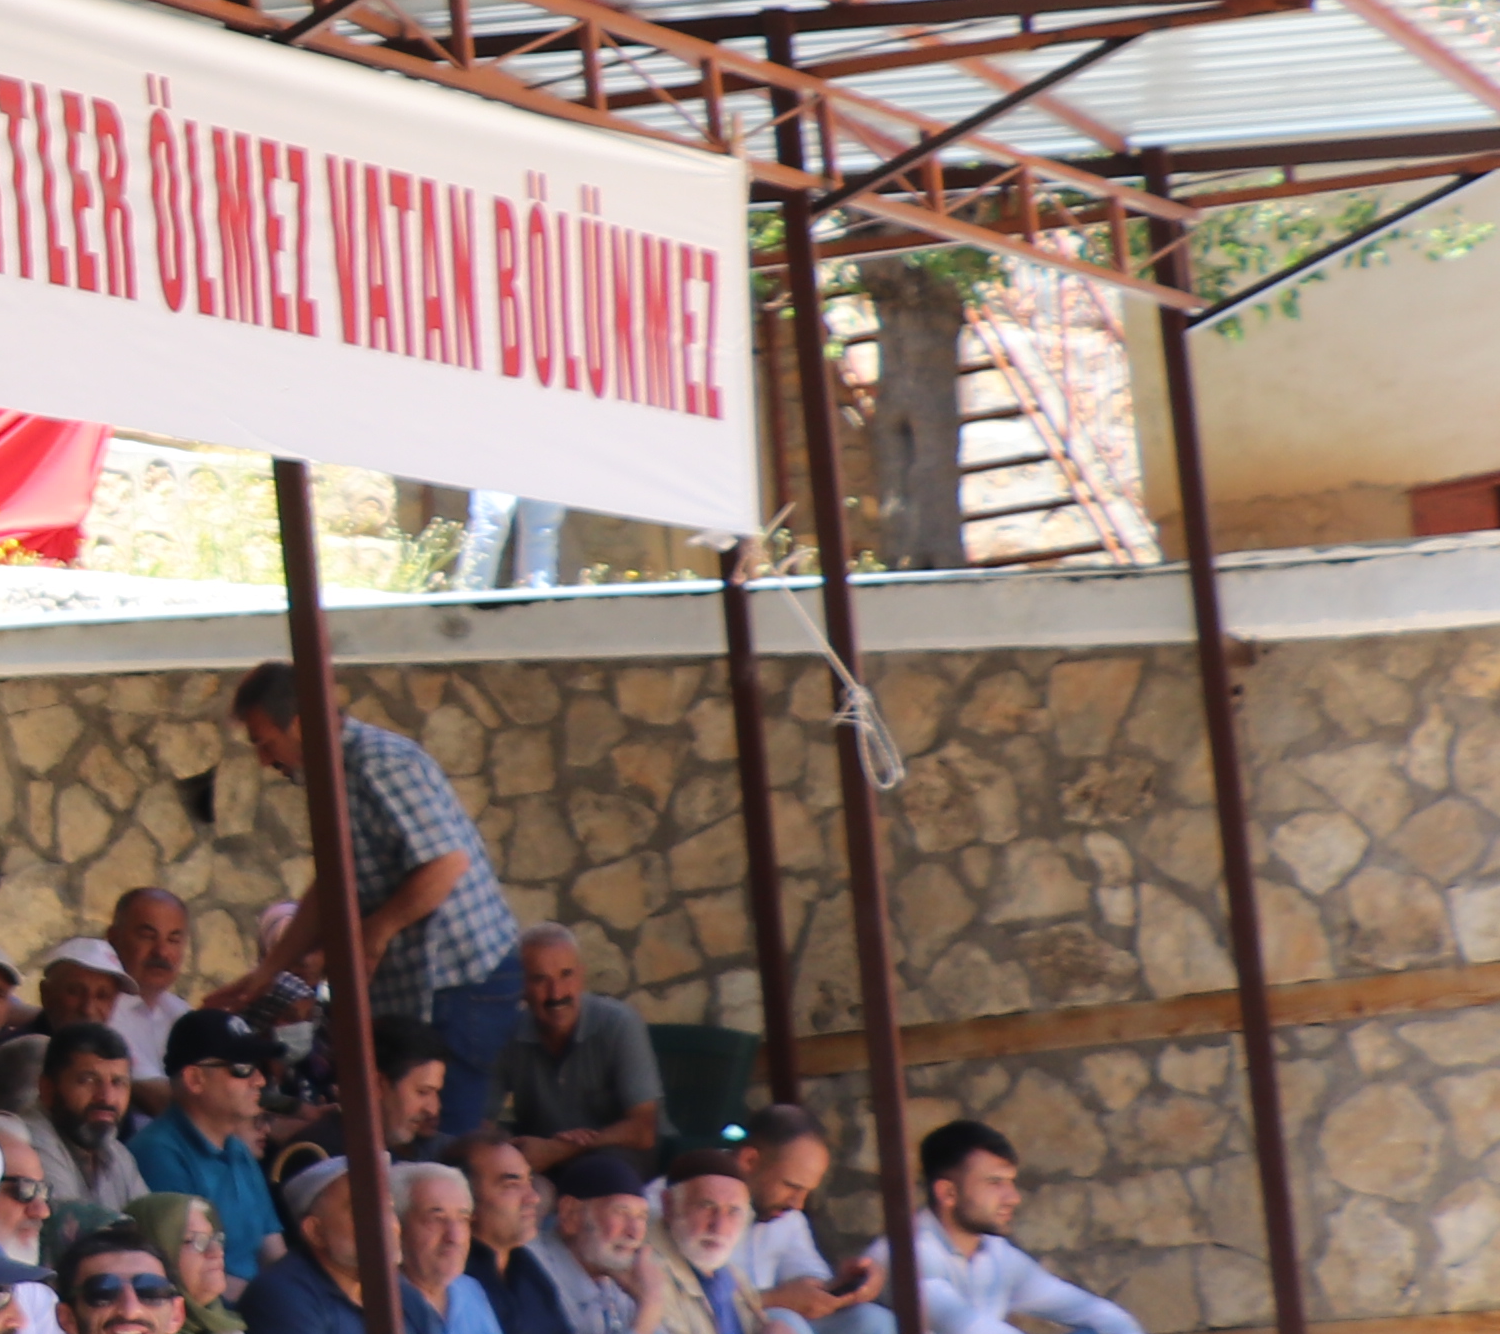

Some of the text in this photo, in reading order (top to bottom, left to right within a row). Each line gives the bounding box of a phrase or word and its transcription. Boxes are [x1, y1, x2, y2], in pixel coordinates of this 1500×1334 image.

[147, 73, 320, 338] ÖLMEZ
[325, 154, 482, 371] VATAN
[493, 170, 723, 420] BÖLÜNMEZ
